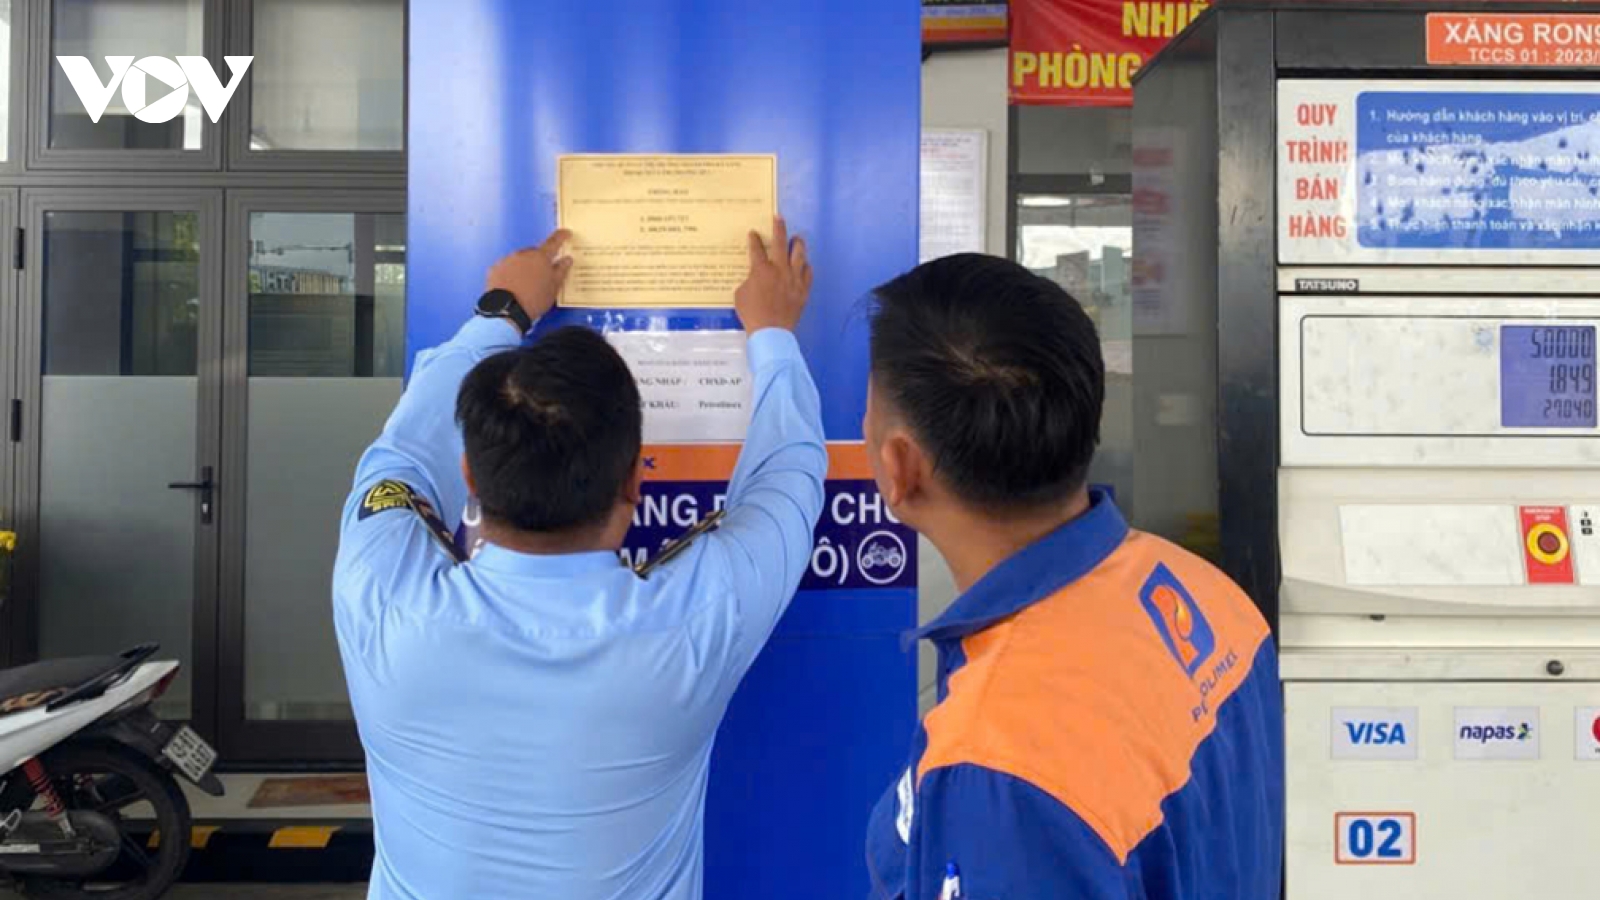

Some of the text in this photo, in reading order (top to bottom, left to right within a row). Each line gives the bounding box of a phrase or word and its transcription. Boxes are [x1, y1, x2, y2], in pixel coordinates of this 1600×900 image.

[1445, 18, 1524, 45] XĂNG
[1013, 44, 1142, 88] PHÒNG
[1470, 48, 1514, 63] TCCS
[1521, 48, 1538, 62] 01
[1556, 47, 1600, 63] 2023/
[1297, 103, 1338, 126] QUY
[1459, 109, 1496, 122] khách
[1498, 109, 1528, 126] hàng
[1532, 110, 1554, 122] vào
[1412, 130, 1450, 143] khách
[1286, 135, 1347, 164] TRÌNH
[1296, 172, 1338, 200] BÁN
[1289, 210, 1346, 238] HÀNG
[1298, 281, 1356, 291] TATSUNO
[1530, 328, 1592, 358] 50000
[1543, 398, 1592, 419] 27040
[812, 536, 849, 585] Ô)
[1343, 721, 1406, 745] VISA
[1459, 723, 1515, 744] napas
[1348, 818, 1402, 858] 02
